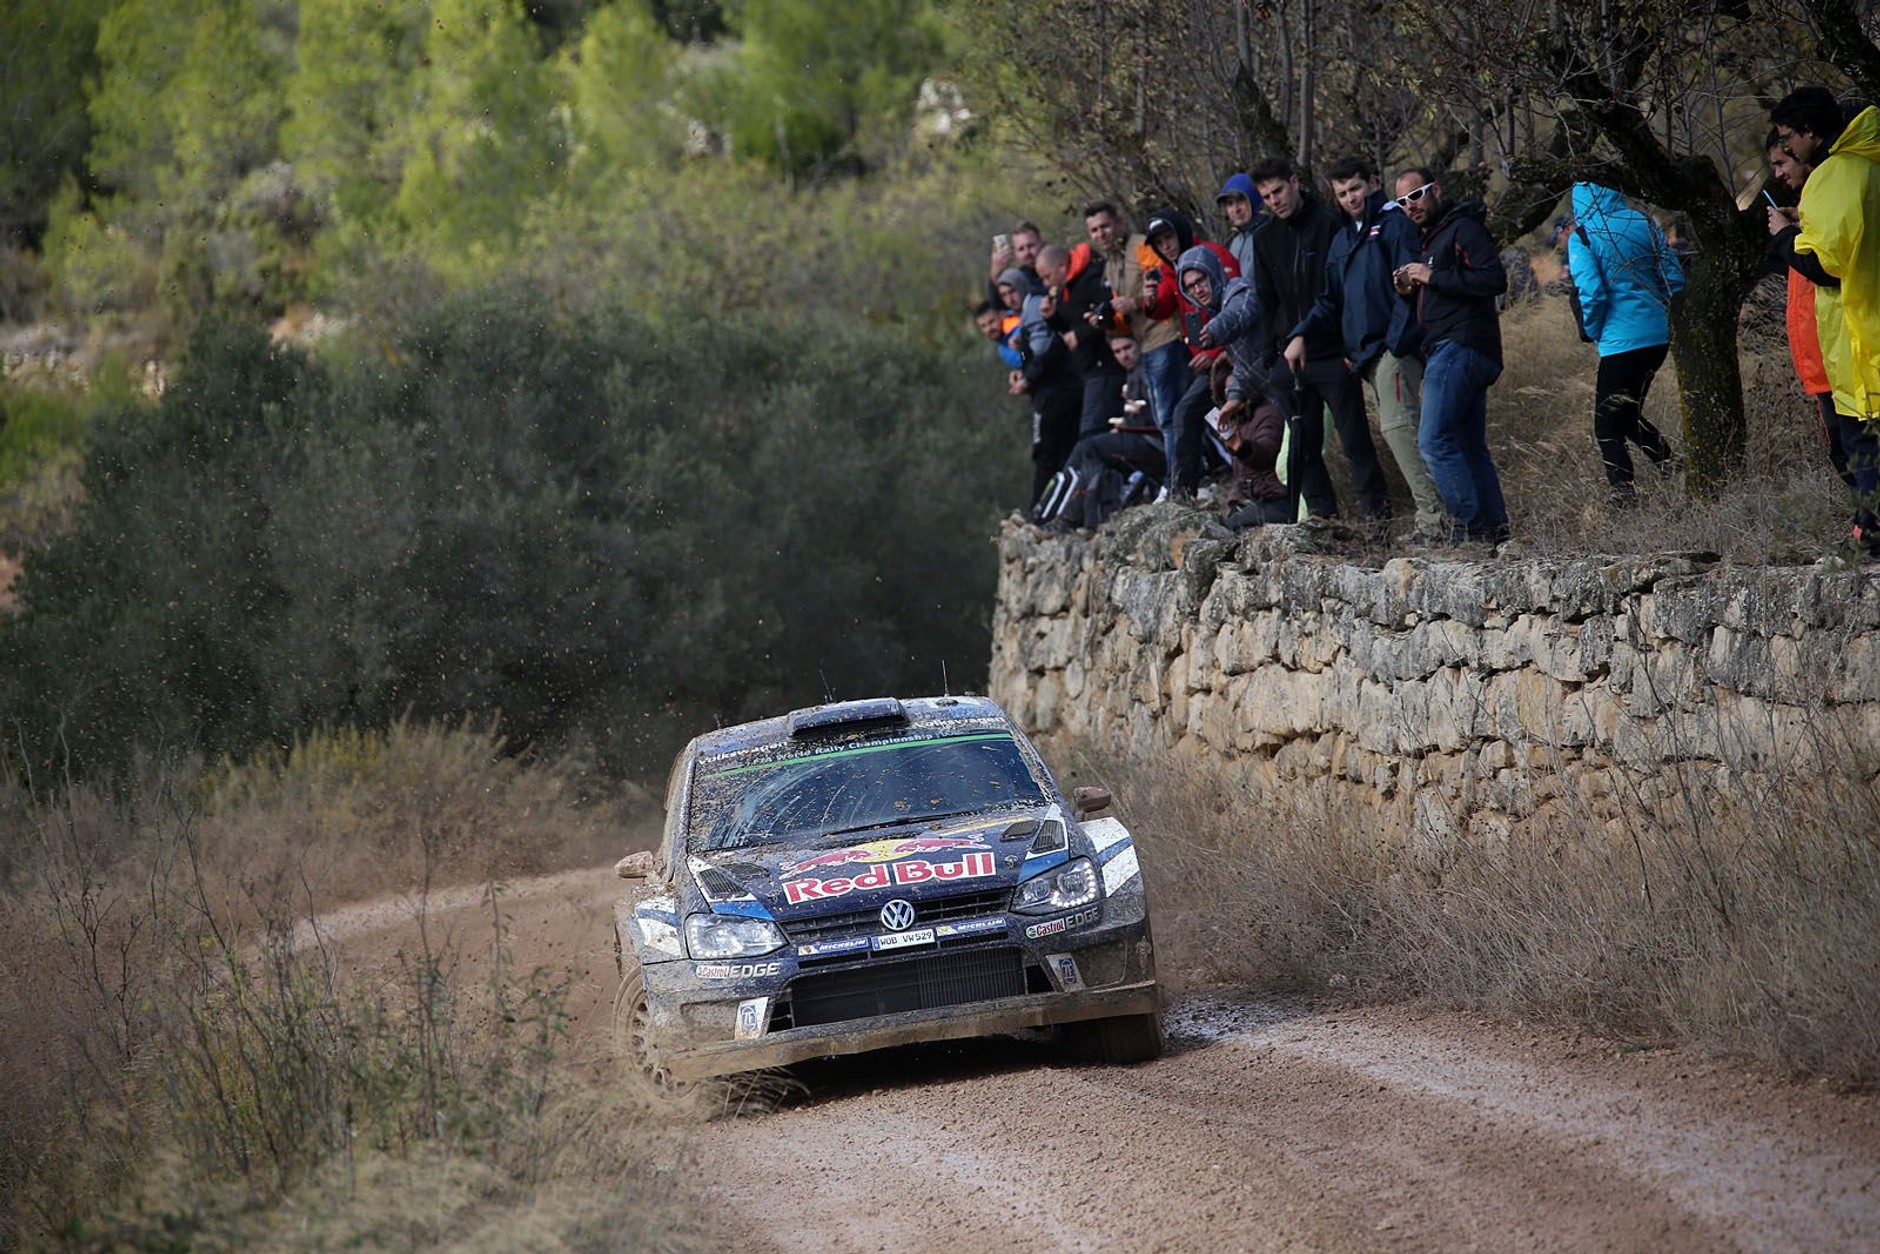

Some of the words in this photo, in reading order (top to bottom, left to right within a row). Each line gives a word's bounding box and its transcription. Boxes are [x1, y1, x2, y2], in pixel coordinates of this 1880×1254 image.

[915, 716, 1005, 728] Volkswagen
[699, 741, 788, 765] Volkswagen
[776, 748, 811, 761] World
[815, 744, 845, 756] Rally
[848, 732, 933, 750] Championship
[783, 865, 891, 904] Red
[892, 852, 997, 885] Bull
[1036, 920, 1065, 936] Castrol
[1065, 906, 1099, 929] EDGE
[818, 938, 867, 951] MICHELIN
[880, 936, 898, 946] WOB
[702, 966, 729, 978] Castrol
[729, 962, 781, 978] EDGE
